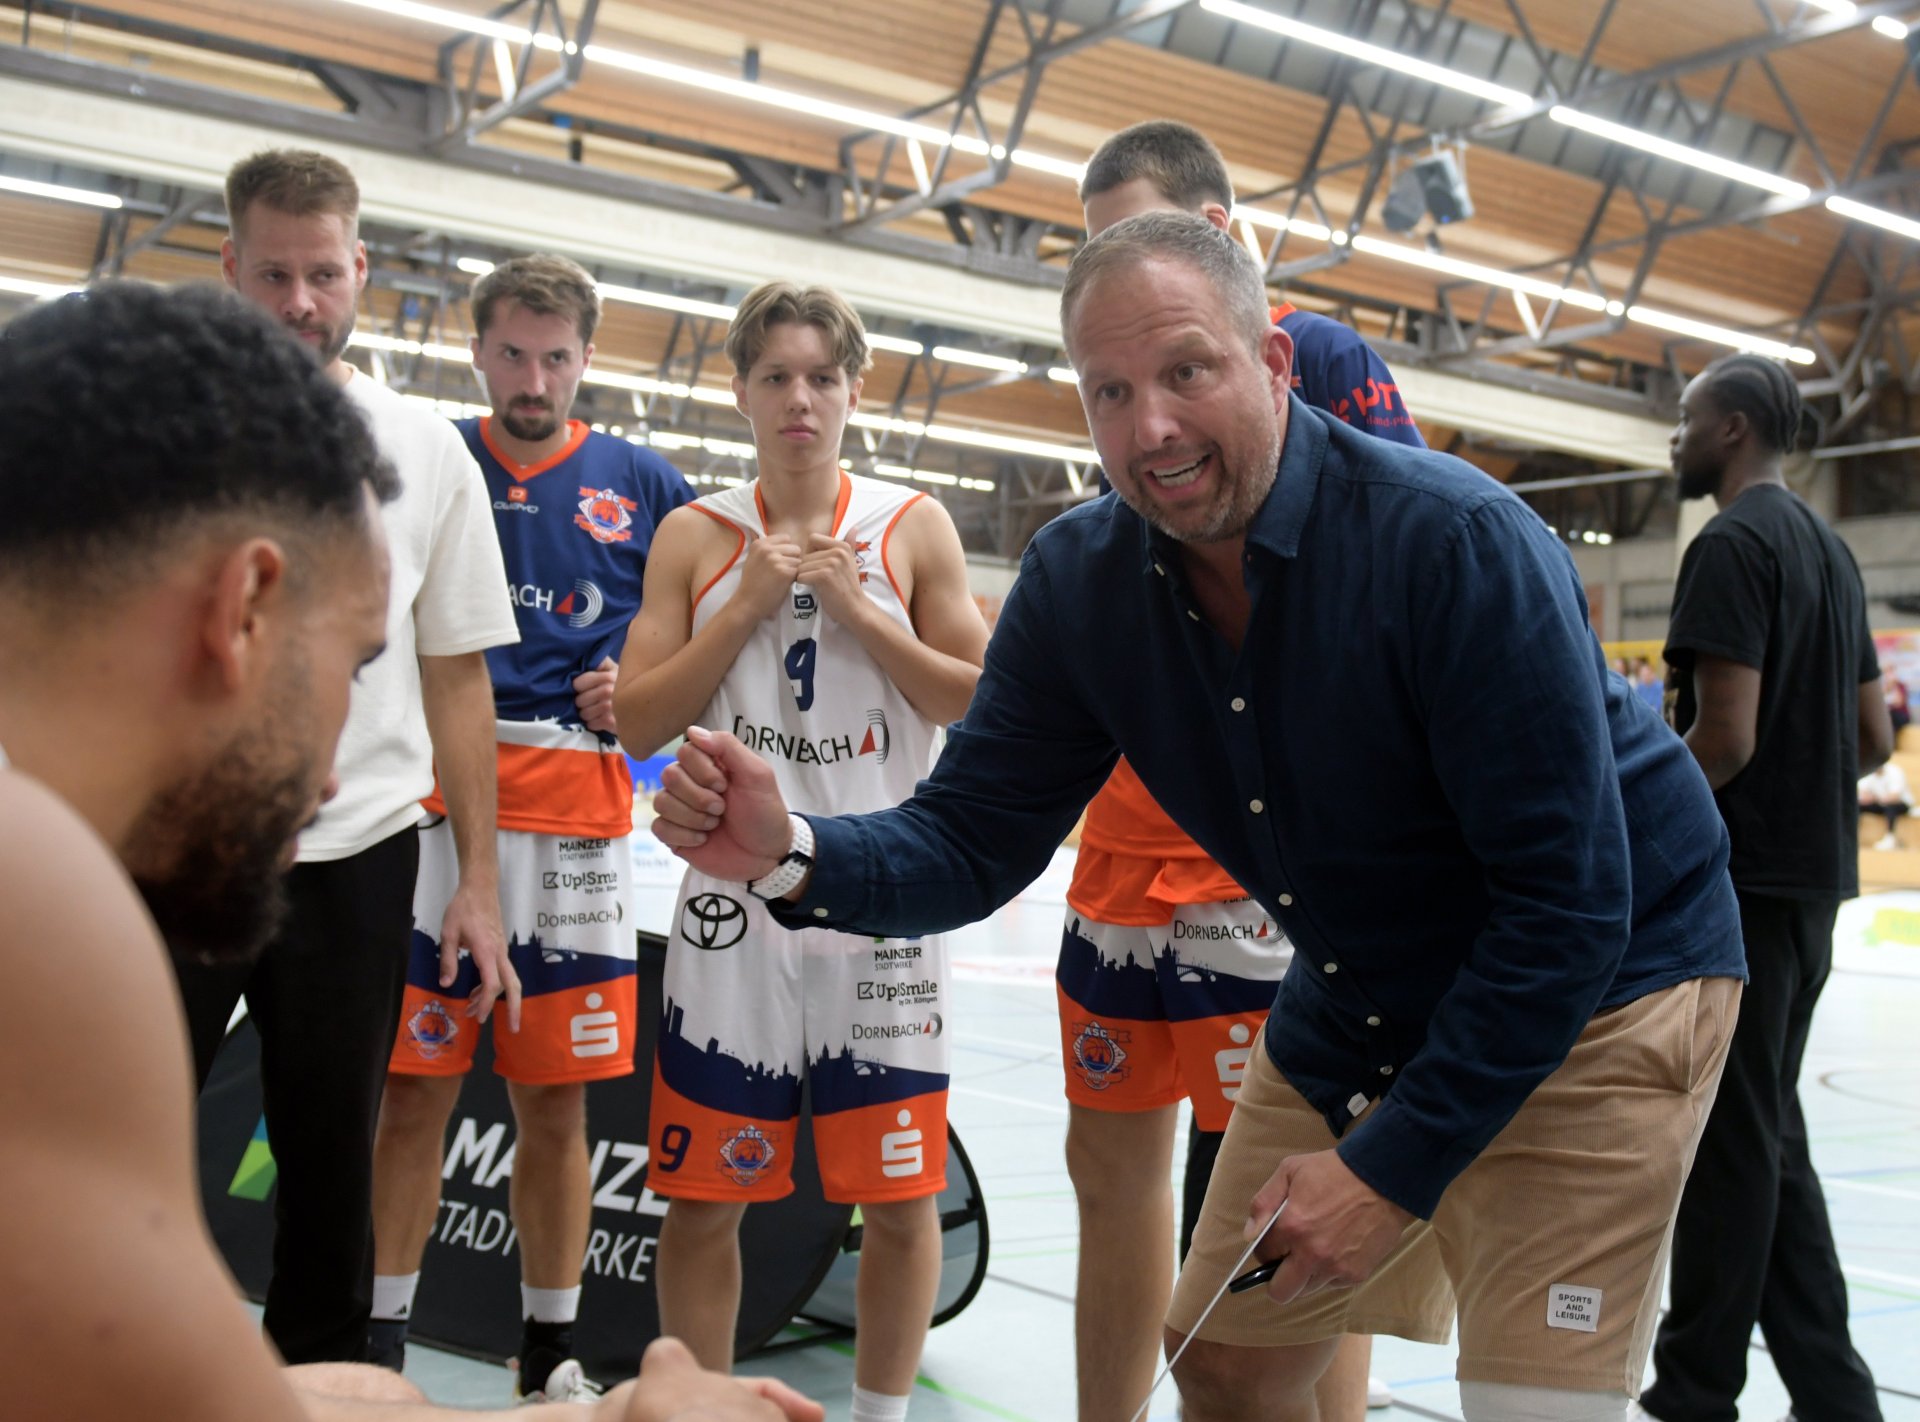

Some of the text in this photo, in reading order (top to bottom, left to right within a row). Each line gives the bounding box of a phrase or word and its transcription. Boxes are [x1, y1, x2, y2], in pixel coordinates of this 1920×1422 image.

[784, 637, 817, 711] 9
[559, 838, 611, 852] MAINZER
[559, 850, 604, 862] STADTWERKE
[537, 910, 612, 928] DORNBACH
[1174, 920, 1254, 940] DORNBACH
[874, 947, 922, 961] MAINZER
[875, 960, 913, 971] STADTWERKE
[876, 980, 938, 1002] Up!Smile
[852, 1024, 922, 1040] DORNBACH
[1084, 1026, 1107, 1038] ASC
[738, 1130, 762, 1138] ASC
[658, 1124, 692, 1172] 9
[1558, 1293, 1592, 1304] SPORTS
[1566, 1303, 1584, 1312] AND
[1555, 1310, 1591, 1322] LEISURE
